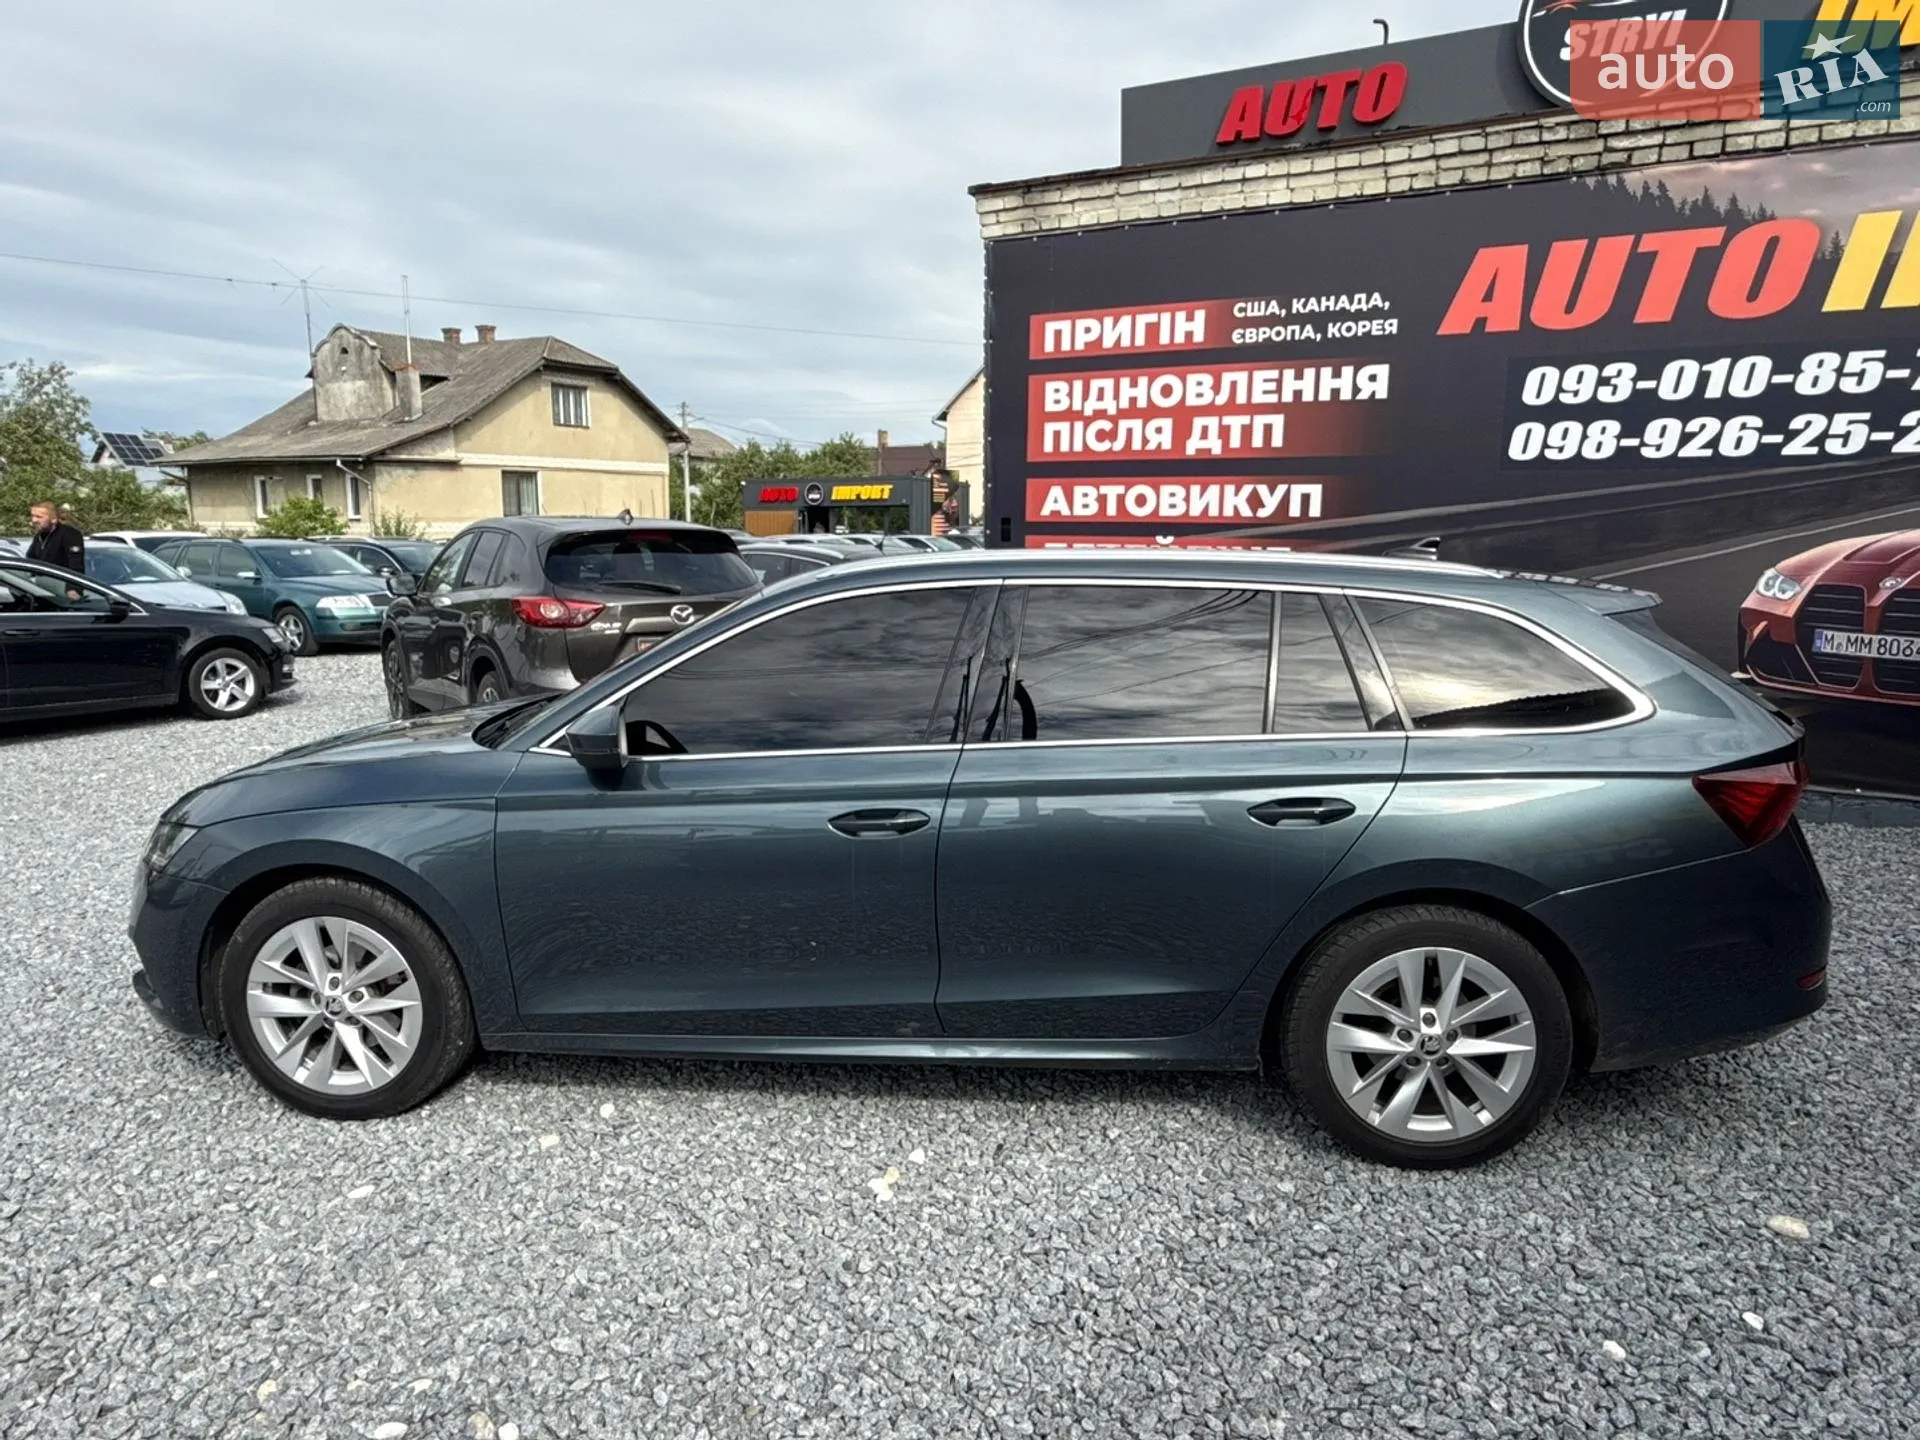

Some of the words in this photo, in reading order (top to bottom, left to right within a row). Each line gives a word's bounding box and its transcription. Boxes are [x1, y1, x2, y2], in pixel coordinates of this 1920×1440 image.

[1559, 8, 1688, 62] STRYI
[1215, 61, 1409, 145] AUTO
[1438, 217, 1822, 335] AUTO
[1820, 209, 1920, 313] I
[1233, 299, 1286, 319] США,
[1292, 291, 1390, 314] КАНАДА,
[1043, 309, 1206, 353] ПРИГІН
[1231, 327, 1322, 345] ЄВРОПА,
[1327, 318, 1398, 338] КОРЕЯ
[1043, 363, 1391, 416] ВІДНОВЛЕННЯ
[1521, 349, 1920, 406] 093-010-85-
[1043, 417, 1173, 453] ПІСЛЯ
[1185, 413, 1284, 455] ДТП
[831, 484, 893, 501] IMPORT
[1040, 483, 1323, 518] АВТОВИКУП
